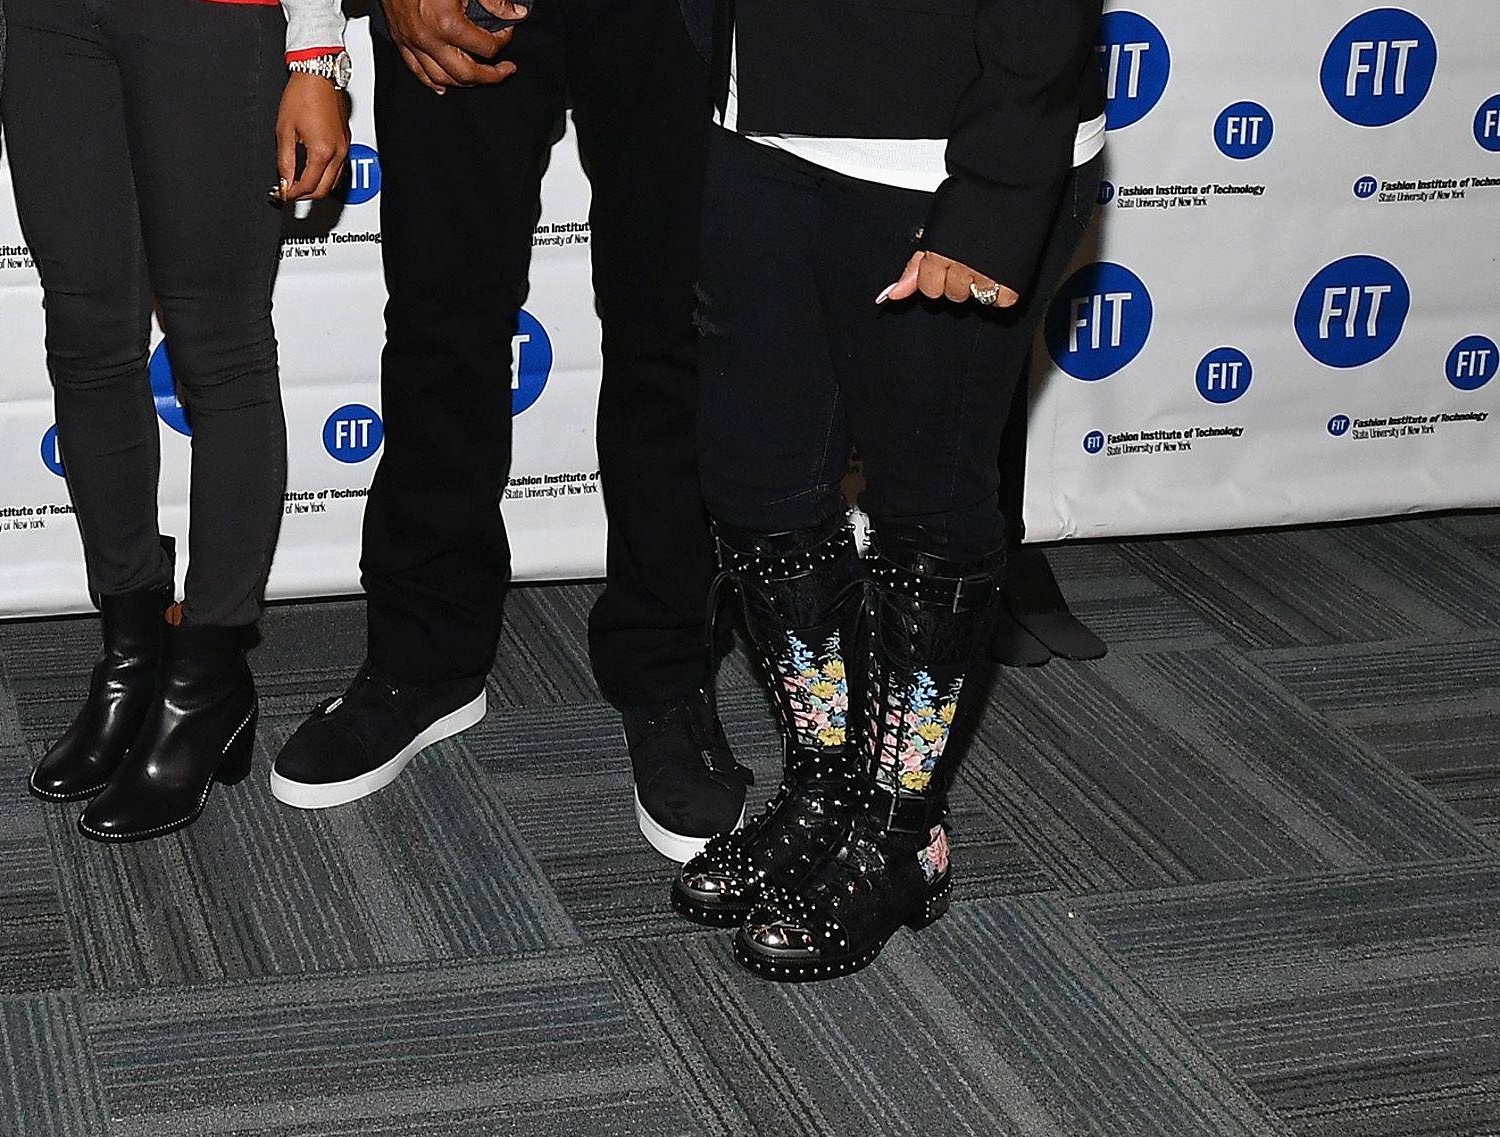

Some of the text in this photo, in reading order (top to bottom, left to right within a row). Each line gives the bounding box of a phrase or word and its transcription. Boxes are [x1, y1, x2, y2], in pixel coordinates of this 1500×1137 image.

[1096, 42, 1150, 100] IT
[1346, 40, 1419, 97] FIT
[1227, 117, 1264, 145] FIT
[351, 159, 374, 189] IT
[1358, 182, 1374, 193] FIT
[1118, 186, 1154, 196] Fashion
[1156, 186, 1198, 195] Institute
[1201, 185, 1212, 194] of
[1213, 184, 1266, 195] Technology
[1068, 292, 1132, 353] FIT
[1320, 285, 1392, 340] FIT
[1207, 362, 1243, 390] FIT
[1456, 350, 1491, 378] FIT
[335, 419, 373, 449] FIT
[1332, 420, 1347, 431] FIT
[1353, 412, 1488, 428] Fashion Institute of Technology
[1088, 436, 1102, 449] FIT
[1107, 427, 1244, 444] Fashion Institute of Technology
[544, 473, 587, 484] Institute
